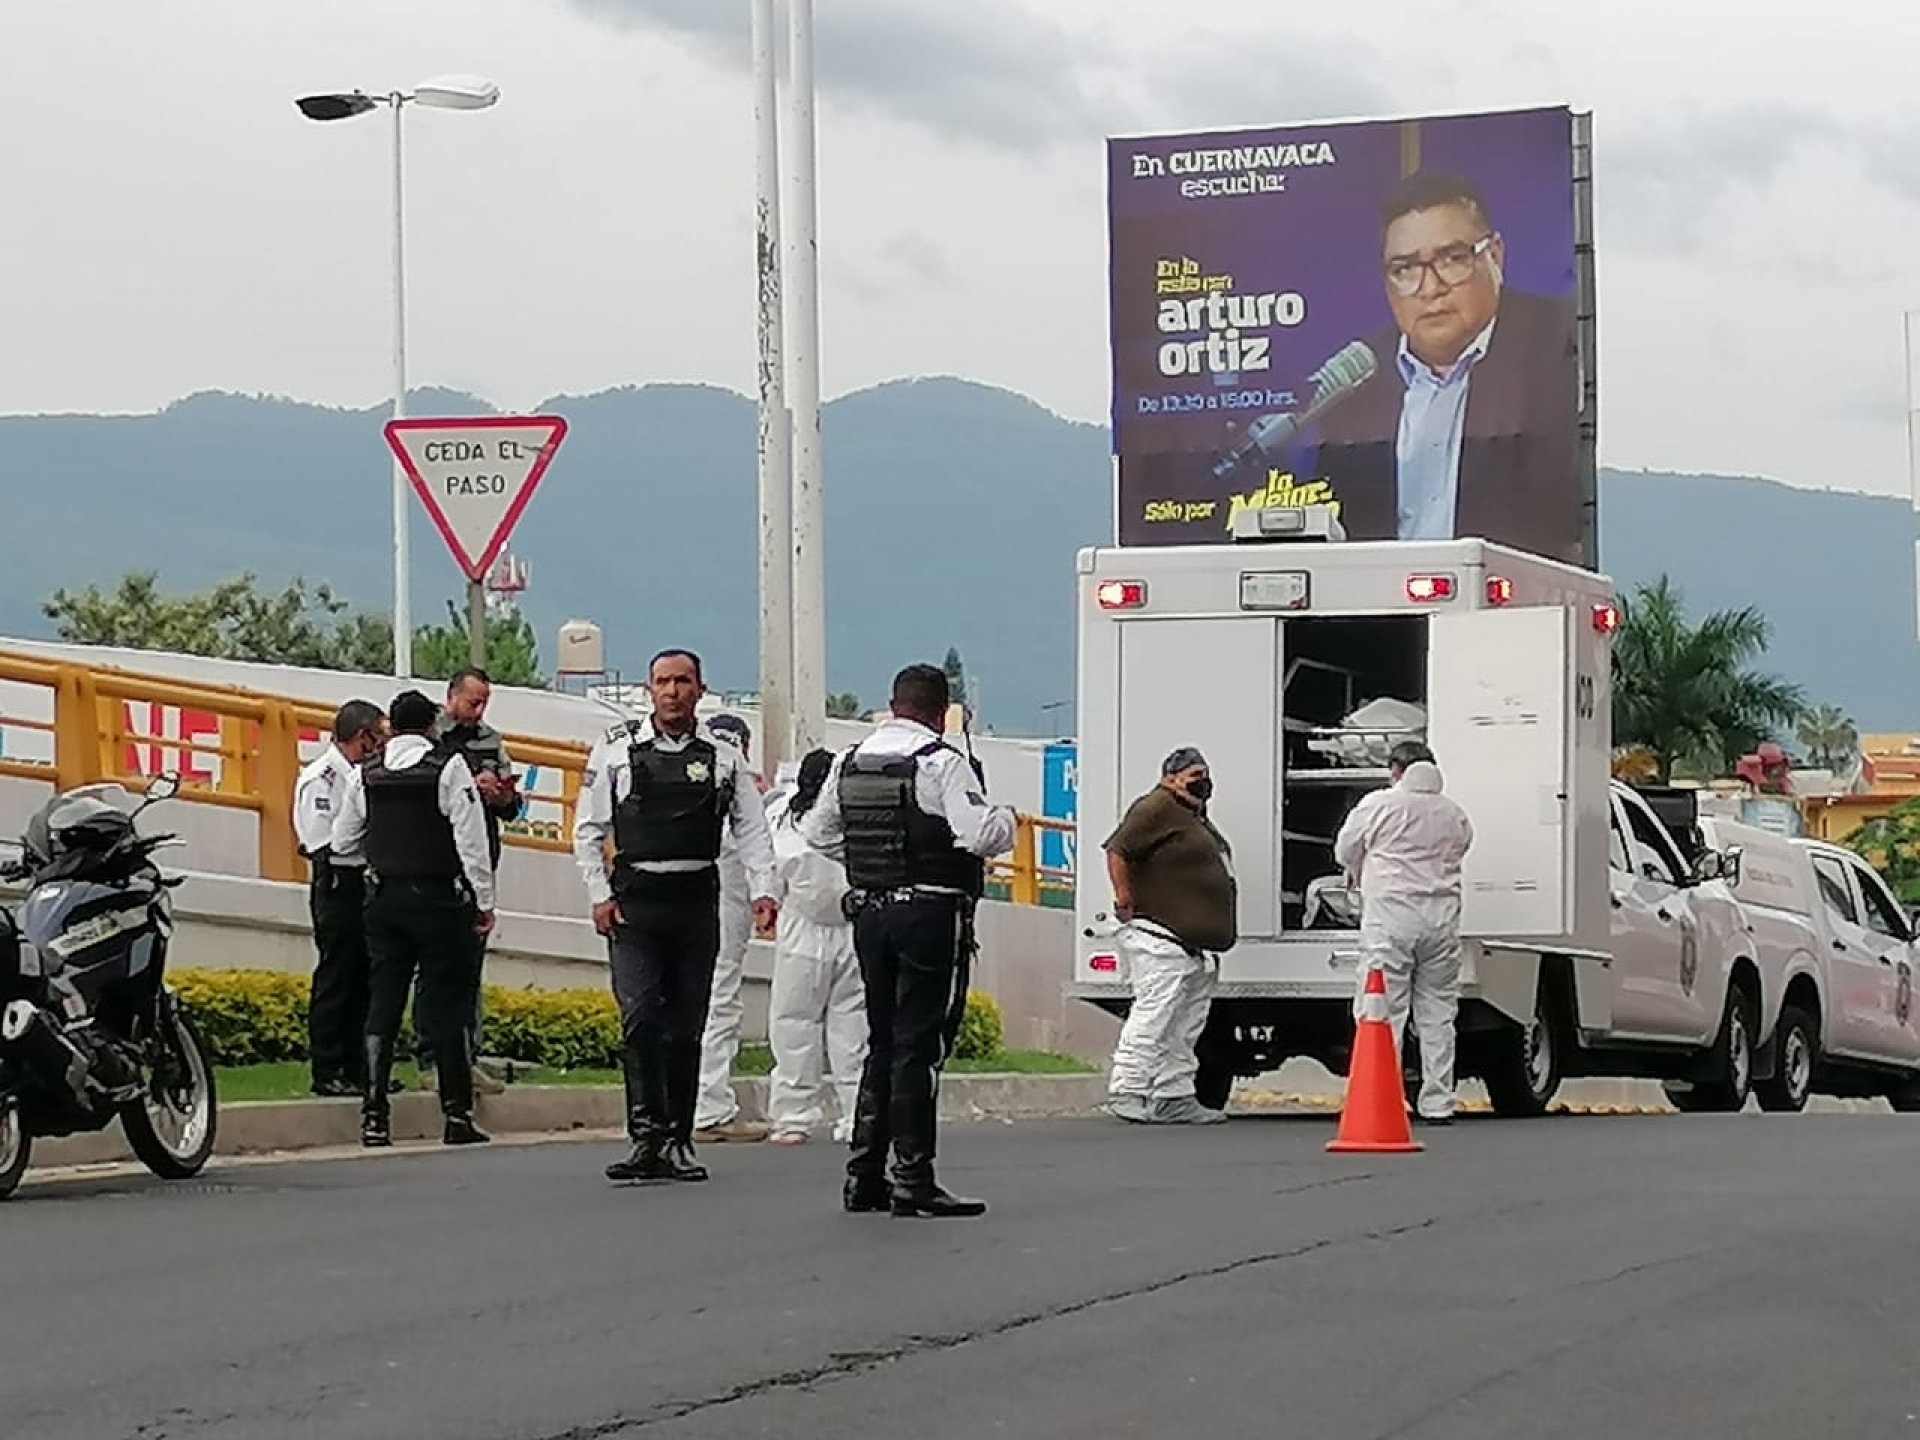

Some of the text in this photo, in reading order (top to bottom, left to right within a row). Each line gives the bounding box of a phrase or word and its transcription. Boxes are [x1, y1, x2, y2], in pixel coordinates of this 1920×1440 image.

[1132, 141, 1335, 177] En CUERNAVACA
[1157, 290, 1305, 332] arturo
[1158, 328, 1270, 376] ortiz
[425, 441, 524, 462] CEDA EL
[446, 474, 505, 495] PASO
